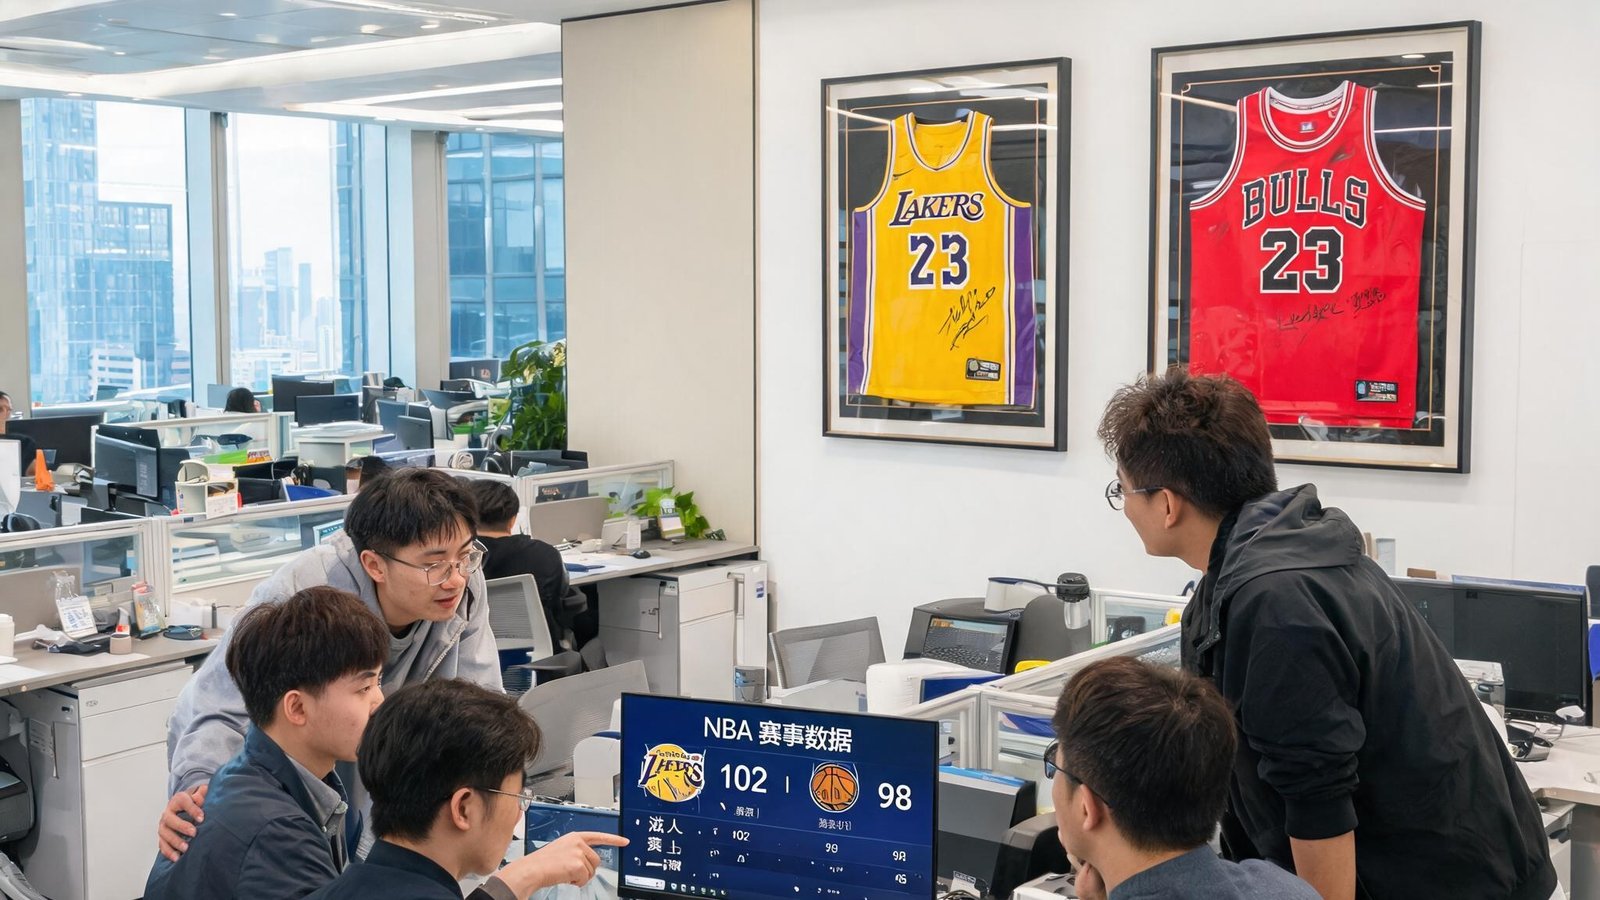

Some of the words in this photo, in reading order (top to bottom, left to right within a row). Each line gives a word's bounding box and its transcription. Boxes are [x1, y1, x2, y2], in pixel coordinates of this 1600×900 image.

[889, 190, 987, 227] LAKERS
[1242, 169, 1369, 229] BULLS
[909, 232, 970, 289] 23
[1260, 226, 1343, 293] 23
[704, 717, 753, 742] NBA
[758, 721, 852, 753] 赛事数据
[721, 764, 767, 793] 102
[878, 783, 912, 811] 98
